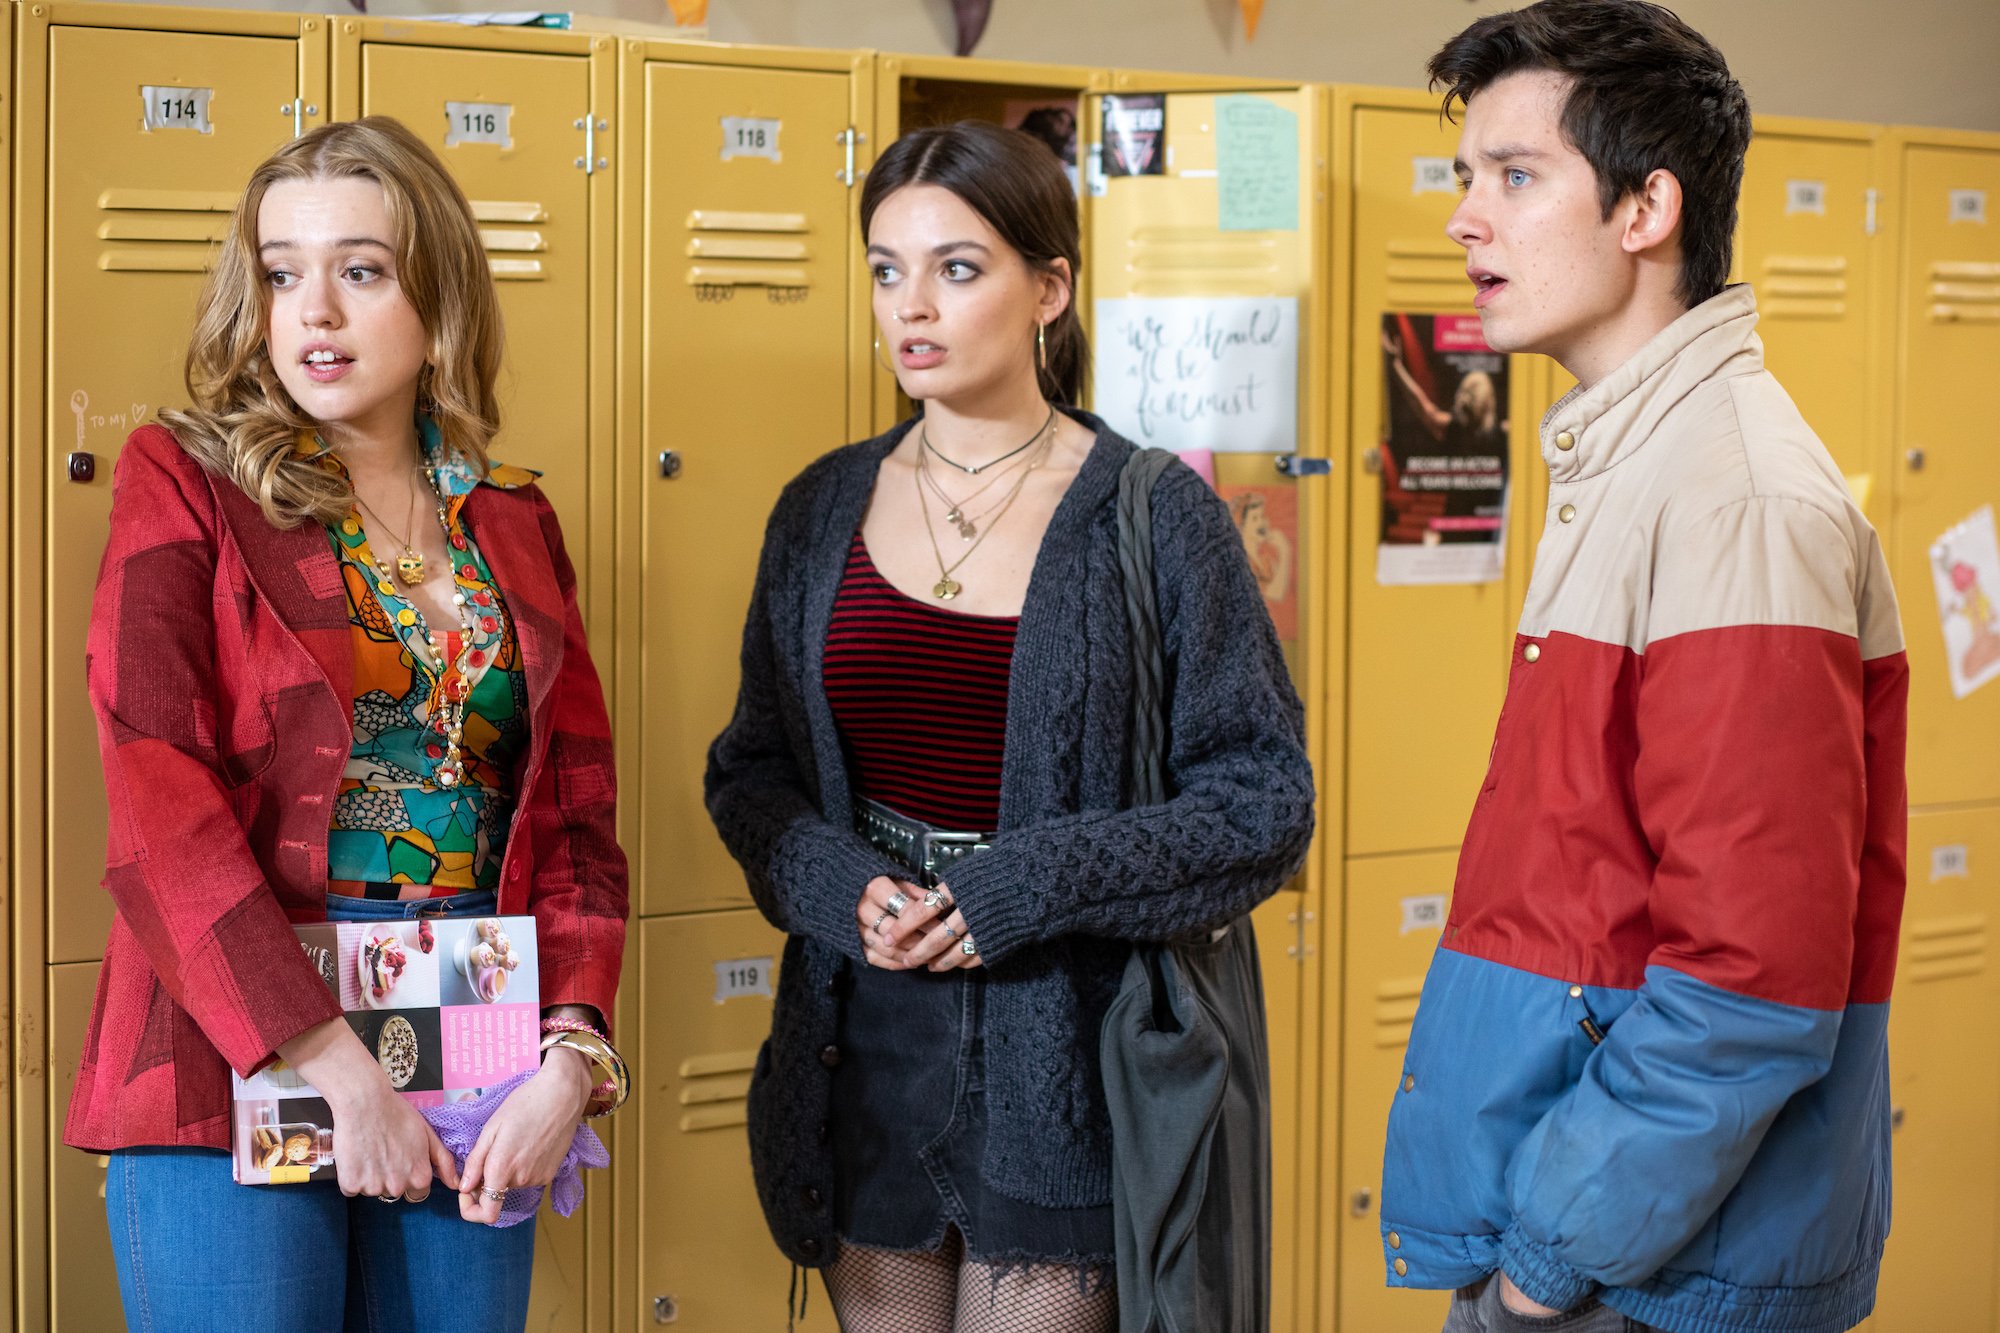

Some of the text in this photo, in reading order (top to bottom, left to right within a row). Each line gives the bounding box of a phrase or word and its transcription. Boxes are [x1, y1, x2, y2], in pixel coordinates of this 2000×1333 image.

[162, 99, 196, 119] 114
[463, 113, 495, 133] 116
[736, 127, 766, 148] 118
[1185, 306, 1281, 360] should
[1176, 349, 1198, 380] be
[1136, 372, 1262, 438] feminist
[89, 413, 126, 431] TO MY
[1406, 456, 1501, 472] BECOME AN ACTOR
[1399, 474, 1503, 490] ALL YEARS WELCOME
[729, 967, 758, 988] 119
[521, 1010, 530, 1020] The
[449, 1013, 457, 1051] Hummingbird
[473, 1033, 481, 1043] and
[484, 1011, 496, 1074] recipes and completely
[497, 1040, 506, 1053] with
[462, 1051, 470, 1062] and
[473, 1045, 482, 1067] updated
[463, 1063, 471, 1073] the
